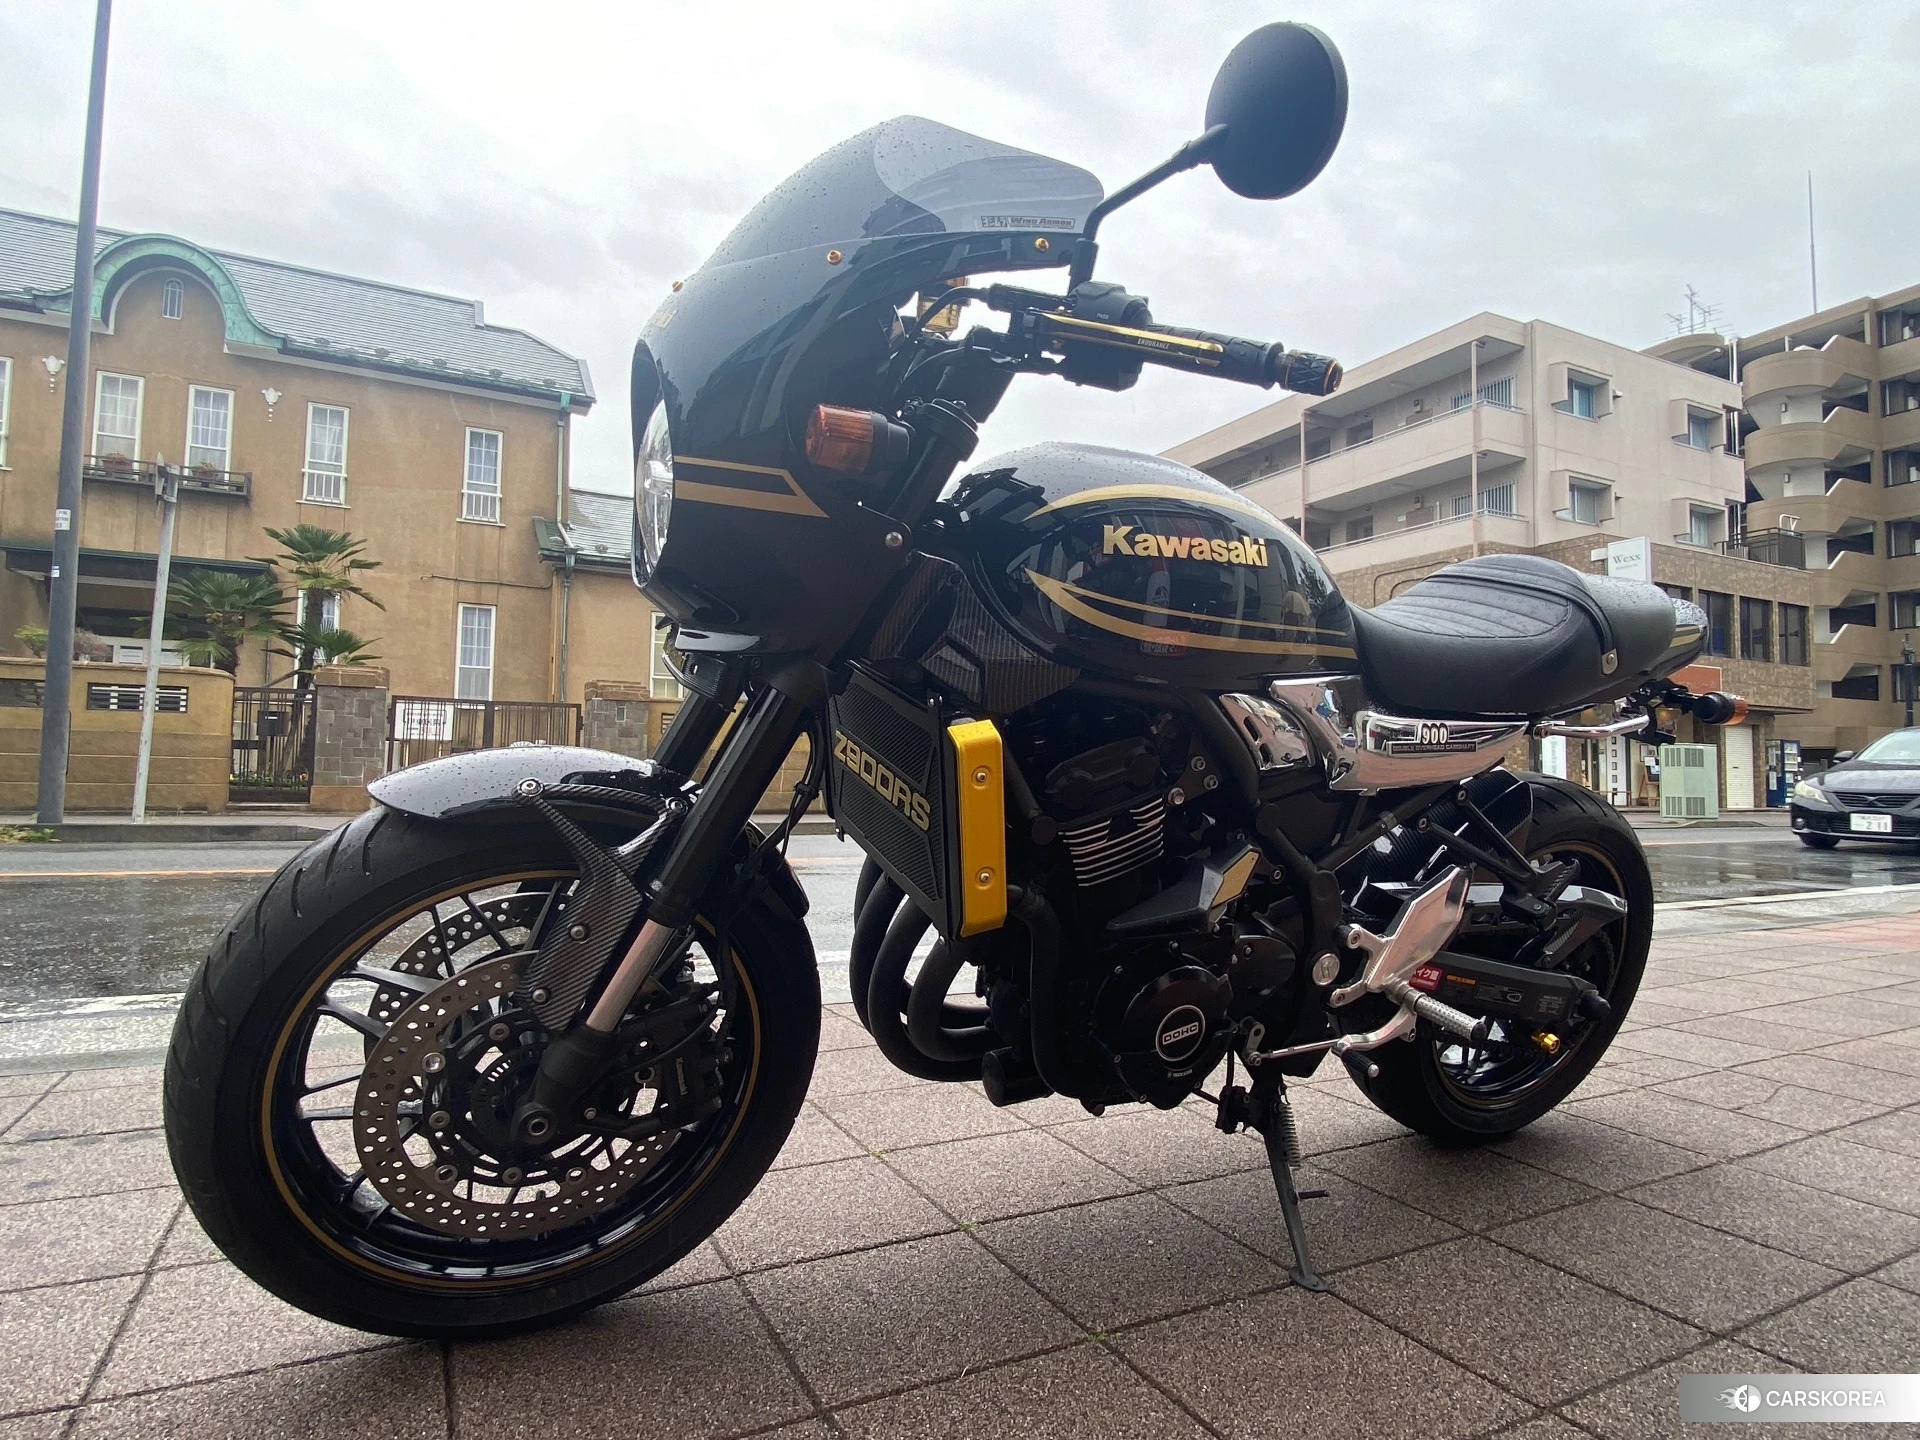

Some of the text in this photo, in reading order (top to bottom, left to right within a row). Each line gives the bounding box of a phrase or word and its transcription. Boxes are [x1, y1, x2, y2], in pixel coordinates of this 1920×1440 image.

[1096, 312, 1110, 320] PASS
[1137, 338, 1170, 350] ENDURANCE
[1103, 524, 1268, 567] Kawasaki
[1421, 724, 1448, 745] 900
[833, 730, 931, 831] Z900RS
[1163, 1024, 1198, 1043] DOHC
